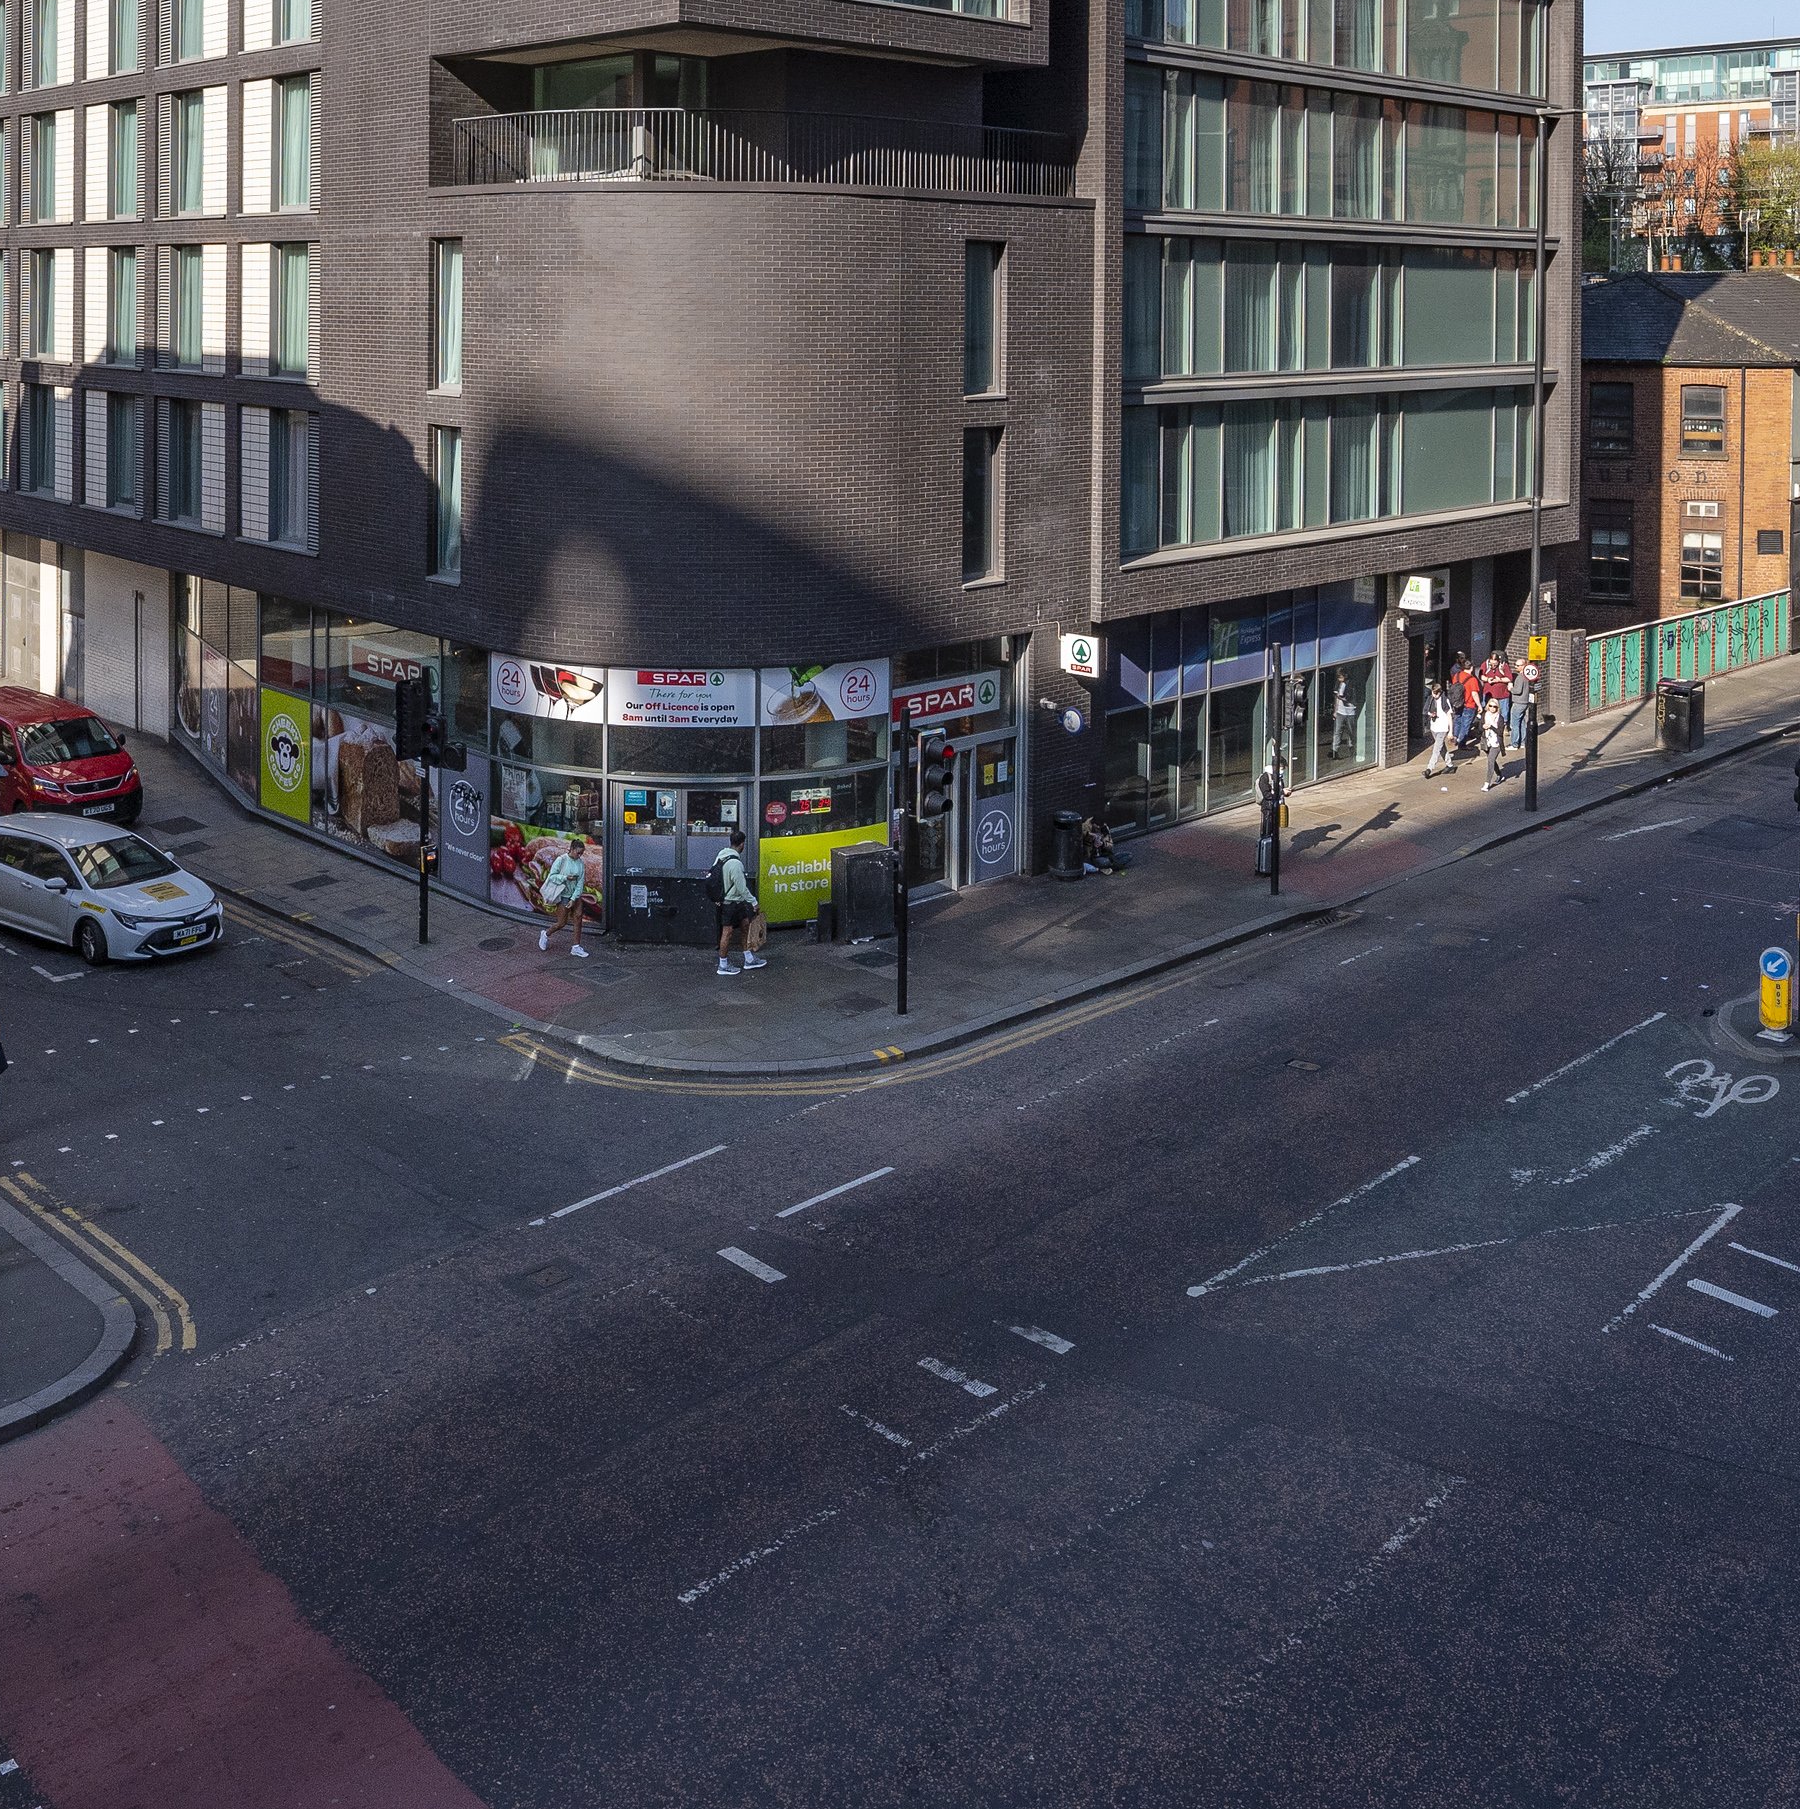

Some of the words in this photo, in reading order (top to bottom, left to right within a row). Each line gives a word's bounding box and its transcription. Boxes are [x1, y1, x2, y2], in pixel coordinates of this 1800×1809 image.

[1071, 665, 1091, 673] SPAR
[1525, 668, 1537, 676] 20
[502, 668, 521, 687] 24
[652, 673, 706, 684] SPAR
[847, 675, 870, 693] 24
[502, 686, 521, 698] hours
[649, 688, 676, 698] There
[678, 688, 694, 701] for
[695, 692, 712, 701] you
[847, 692, 870, 704] hours
[626, 702, 644, 710] Our
[645, 702, 661, 710] Off
[662, 702, 699, 711] Licence
[701, 703, 709, 711] is
[711, 703, 735, 713] open
[907, 688, 974, 715] SPAR
[622, 713, 643, 722] 8am
[645, 714, 667, 723] until
[668, 715, 690, 723] 3am
[691, 715, 738, 725] Everyday
[271, 717, 299, 742] CHEEKY
[270, 754, 294, 787] COFFEE
[455, 811, 475, 827] hours
[982, 818, 1005, 842] 24
[981, 841, 1006, 855] hours
[774, 880, 788, 893] in
[790, 878, 829, 892] store
